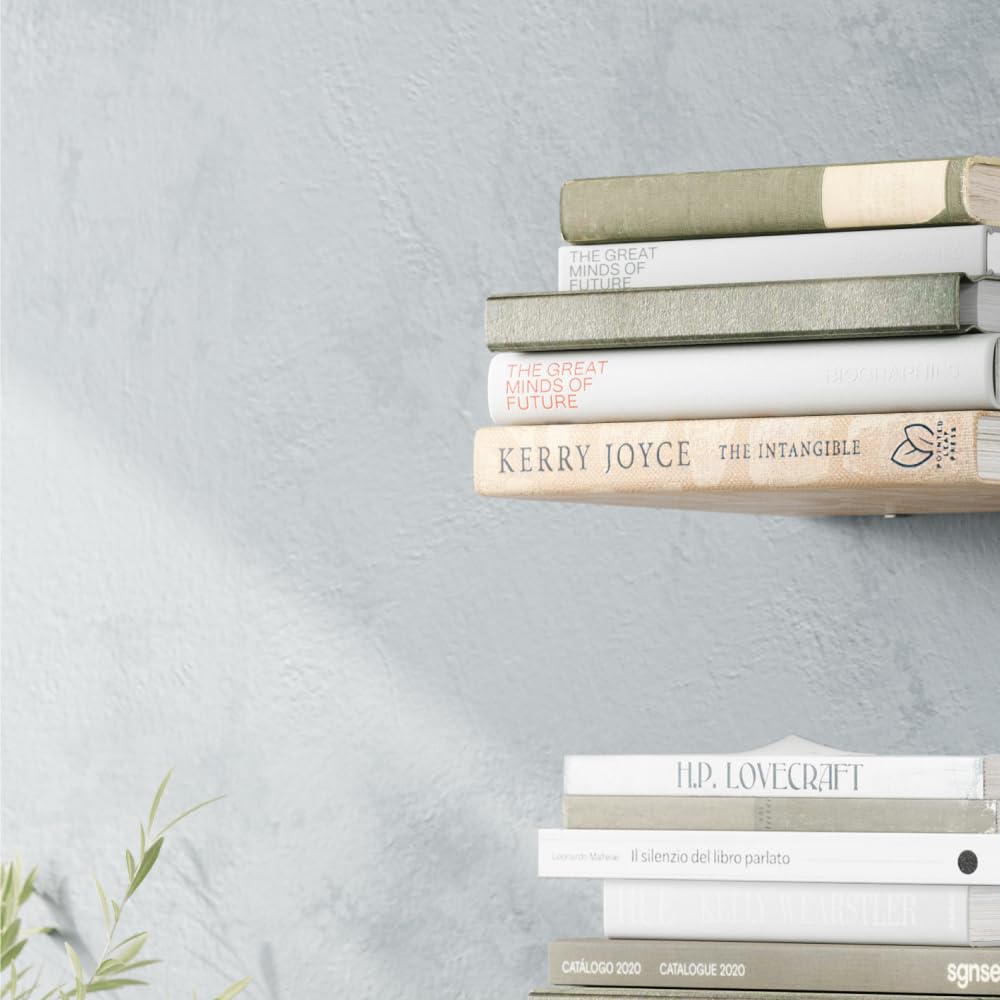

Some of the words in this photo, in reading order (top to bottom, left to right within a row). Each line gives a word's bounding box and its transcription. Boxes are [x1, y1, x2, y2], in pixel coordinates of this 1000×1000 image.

[569, 250, 601, 263] THE
[605, 246, 658, 261] GREAT
[569, 263, 620, 278] MINDS
[624, 261, 647, 275] OF
[569, 277, 632, 291] FUTURE
[507, 363, 543, 378] THE
[547, 360, 609, 377] GREAT
[505, 378, 563, 394] MINDS
[568, 377, 593, 392] OF
[506, 394, 579, 411] FUTURE
[498, 445, 591, 473] KERRY
[604, 440, 692, 474] JOYCE
[719, 443, 751, 460] THE
[758, 439, 862, 459] INTANGIBLE
[677, 761, 717, 789] H.P.
[726, 761, 864, 792] LOVECRAFT
[641, 848, 688, 864] silenzio
[691, 848, 711, 864] del
[713, 849, 743, 865] libro
[745, 849, 791, 868] parlato
[562, 958, 614, 975] CATÁLOGO
[616, 962, 642, 975] 2020
[659, 962, 717, 976] CATALOGUE
[719, 963, 746, 977] 2020
